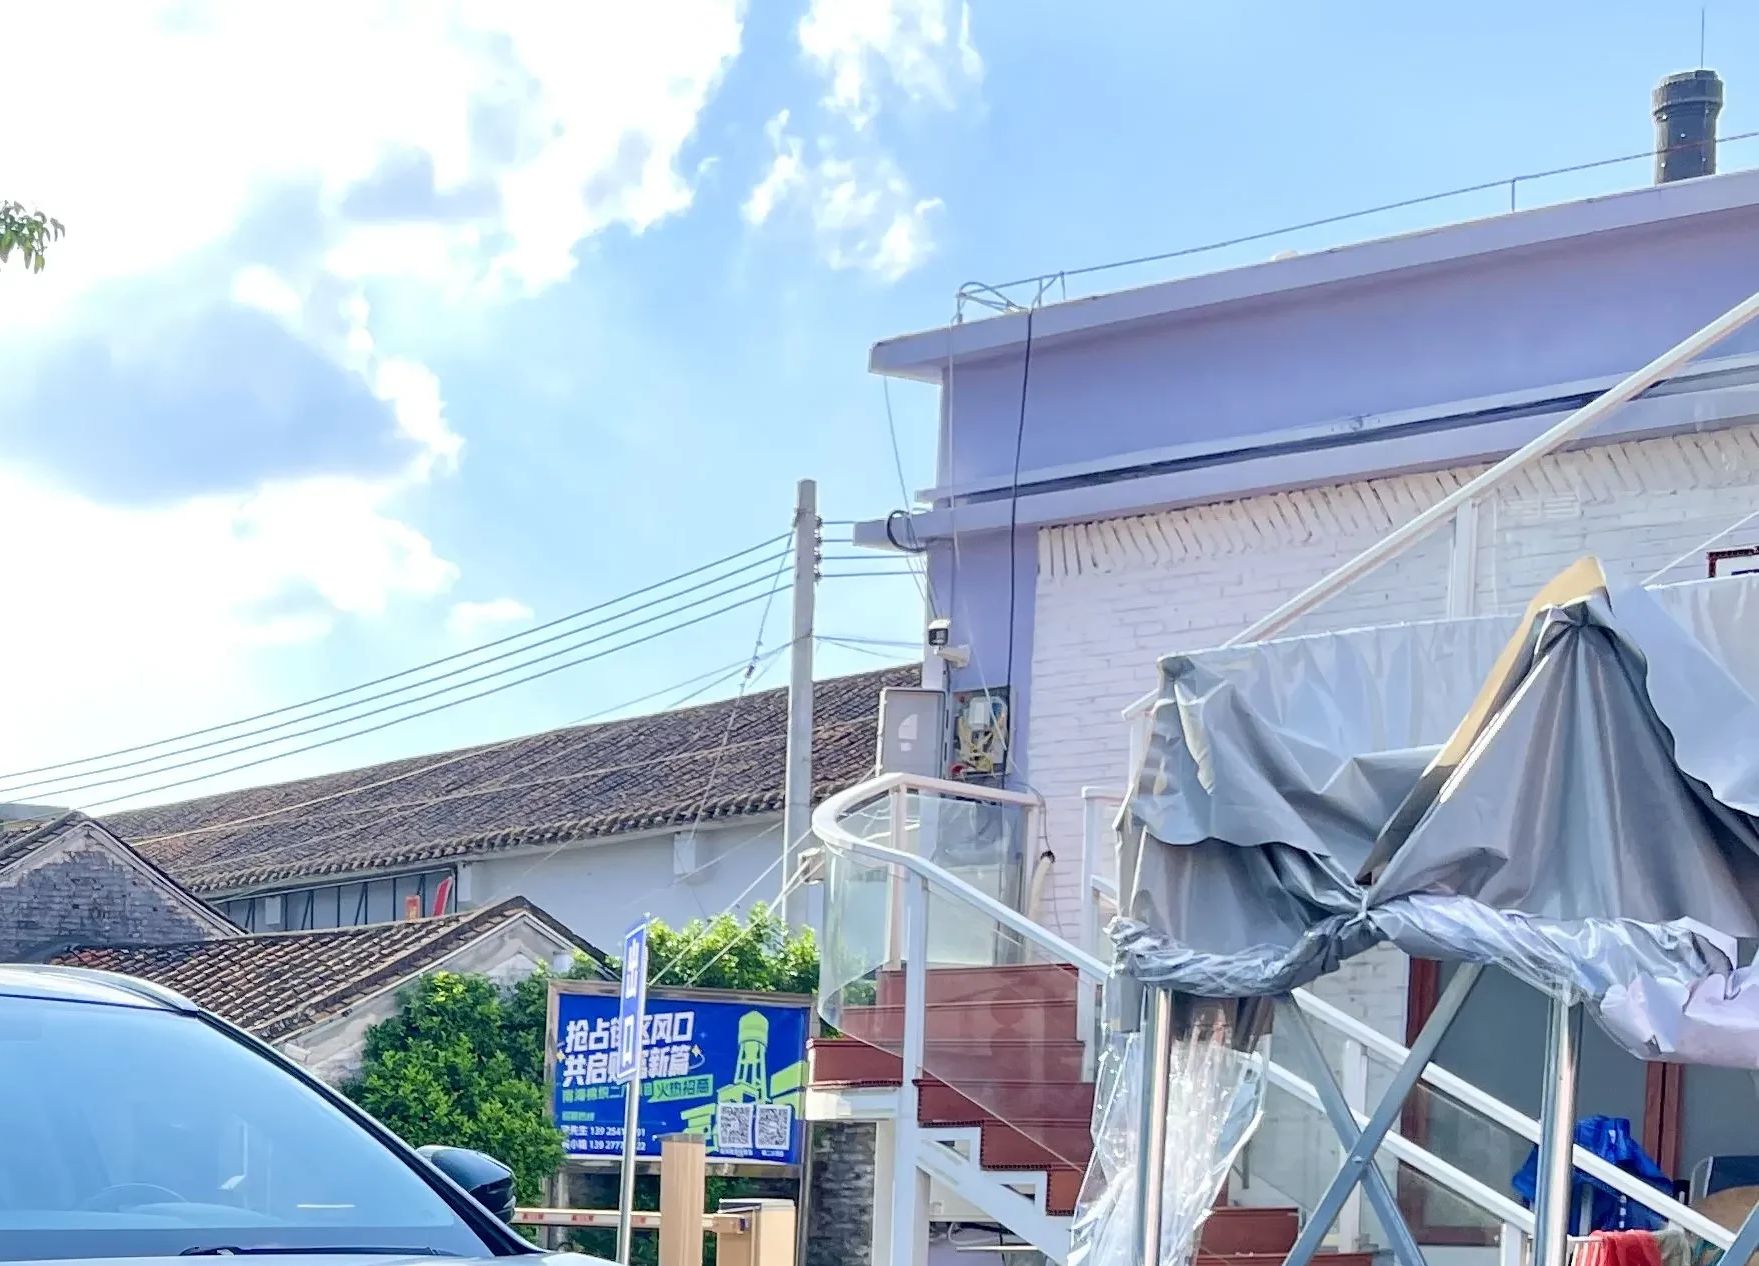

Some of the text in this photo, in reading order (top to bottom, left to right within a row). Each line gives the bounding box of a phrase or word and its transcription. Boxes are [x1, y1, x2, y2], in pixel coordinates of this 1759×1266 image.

[622, 938, 640, 1068] 出口
[656, 1078, 709, 1099] 火热招商
